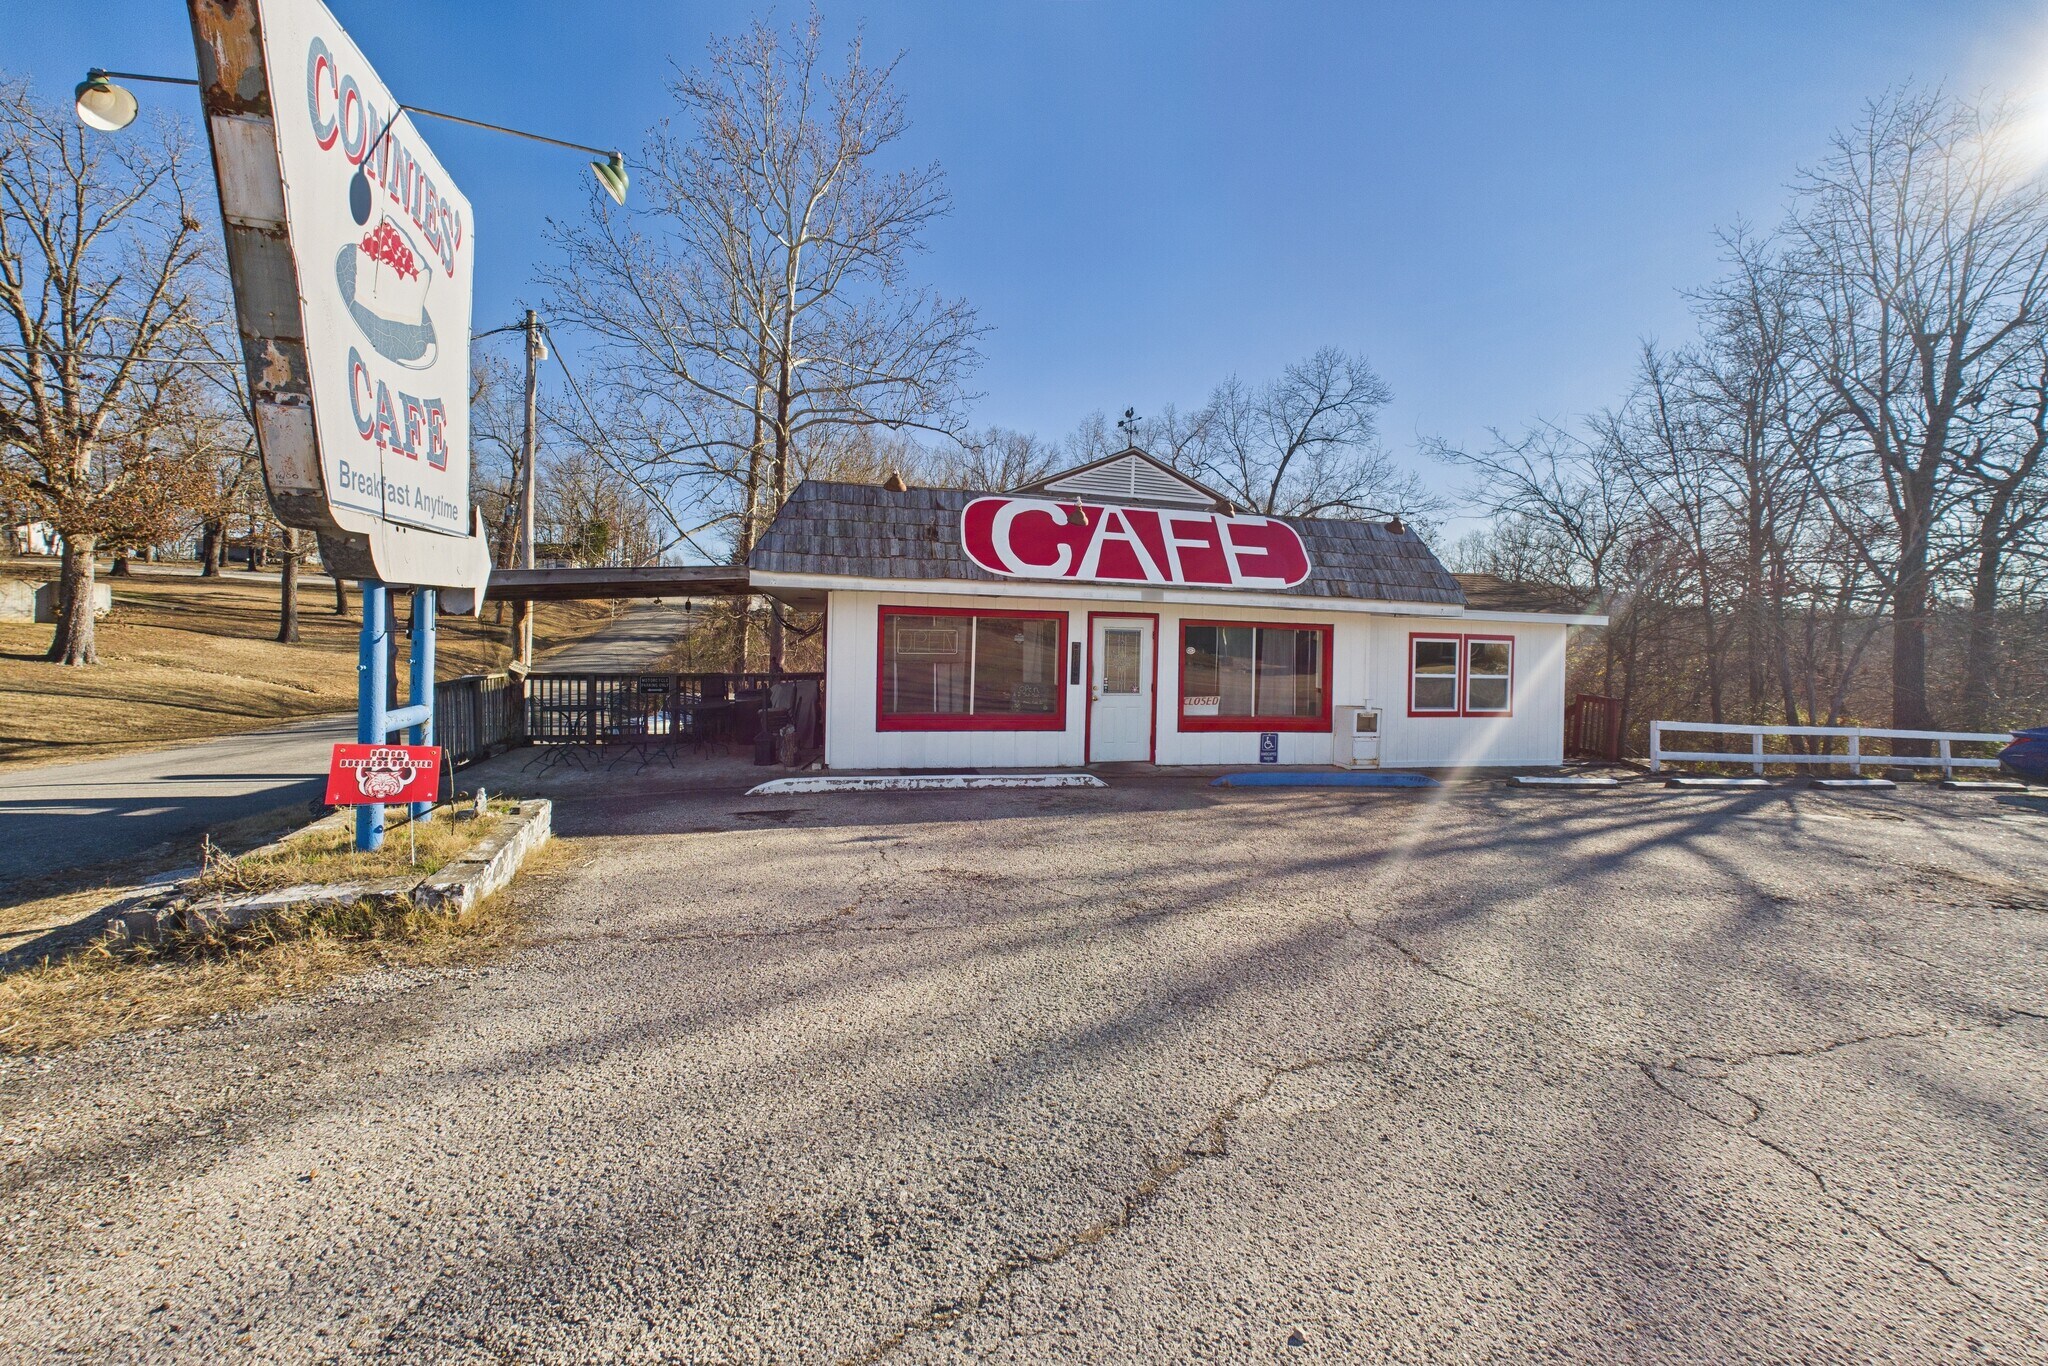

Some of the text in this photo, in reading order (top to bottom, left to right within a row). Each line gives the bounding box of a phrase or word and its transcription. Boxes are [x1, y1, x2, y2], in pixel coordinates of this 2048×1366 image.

[348, 346, 448, 472] CAFE
[339, 459, 459, 520] Breakfast Anytime
[991, 500, 1288, 589] CAFE
[1184, 697, 1219, 706] CLOSED
[340, 759, 433, 769] BUSINESS BOOSTER
[370, 749, 407, 758] BOBCAT
